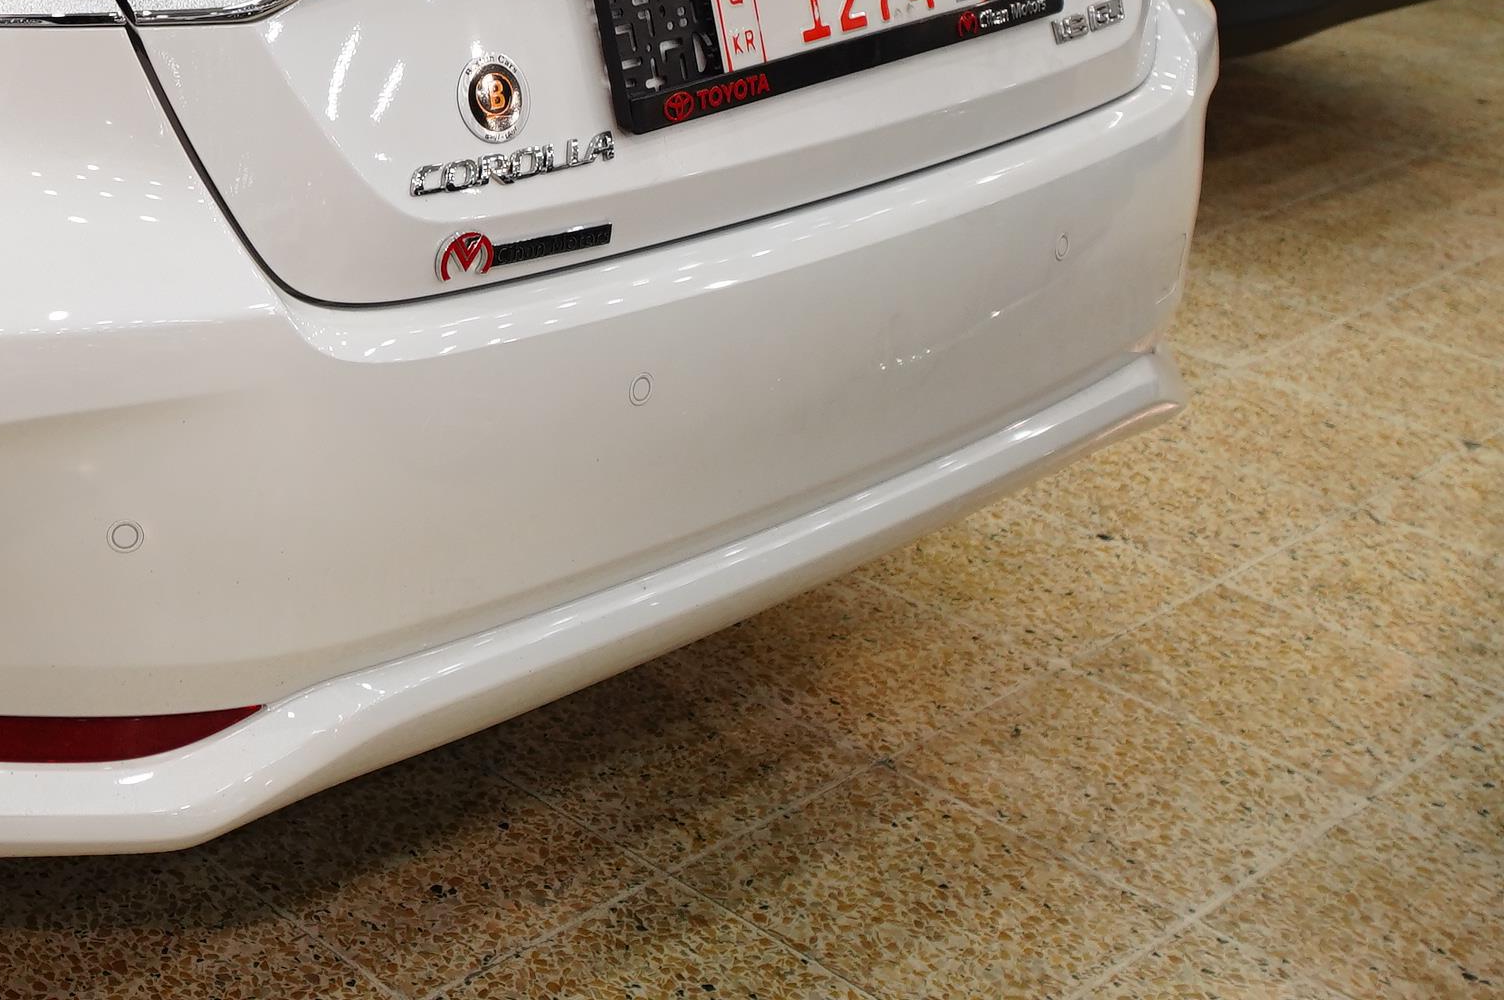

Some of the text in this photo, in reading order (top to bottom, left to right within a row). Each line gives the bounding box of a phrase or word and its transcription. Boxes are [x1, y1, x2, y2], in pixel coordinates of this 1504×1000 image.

[979, 8, 1010, 29] Cihan
[731, 29, 757, 56] KR
[695, 72, 771, 112] TOYOTA
[409, 130, 616, 197] COROLLA
